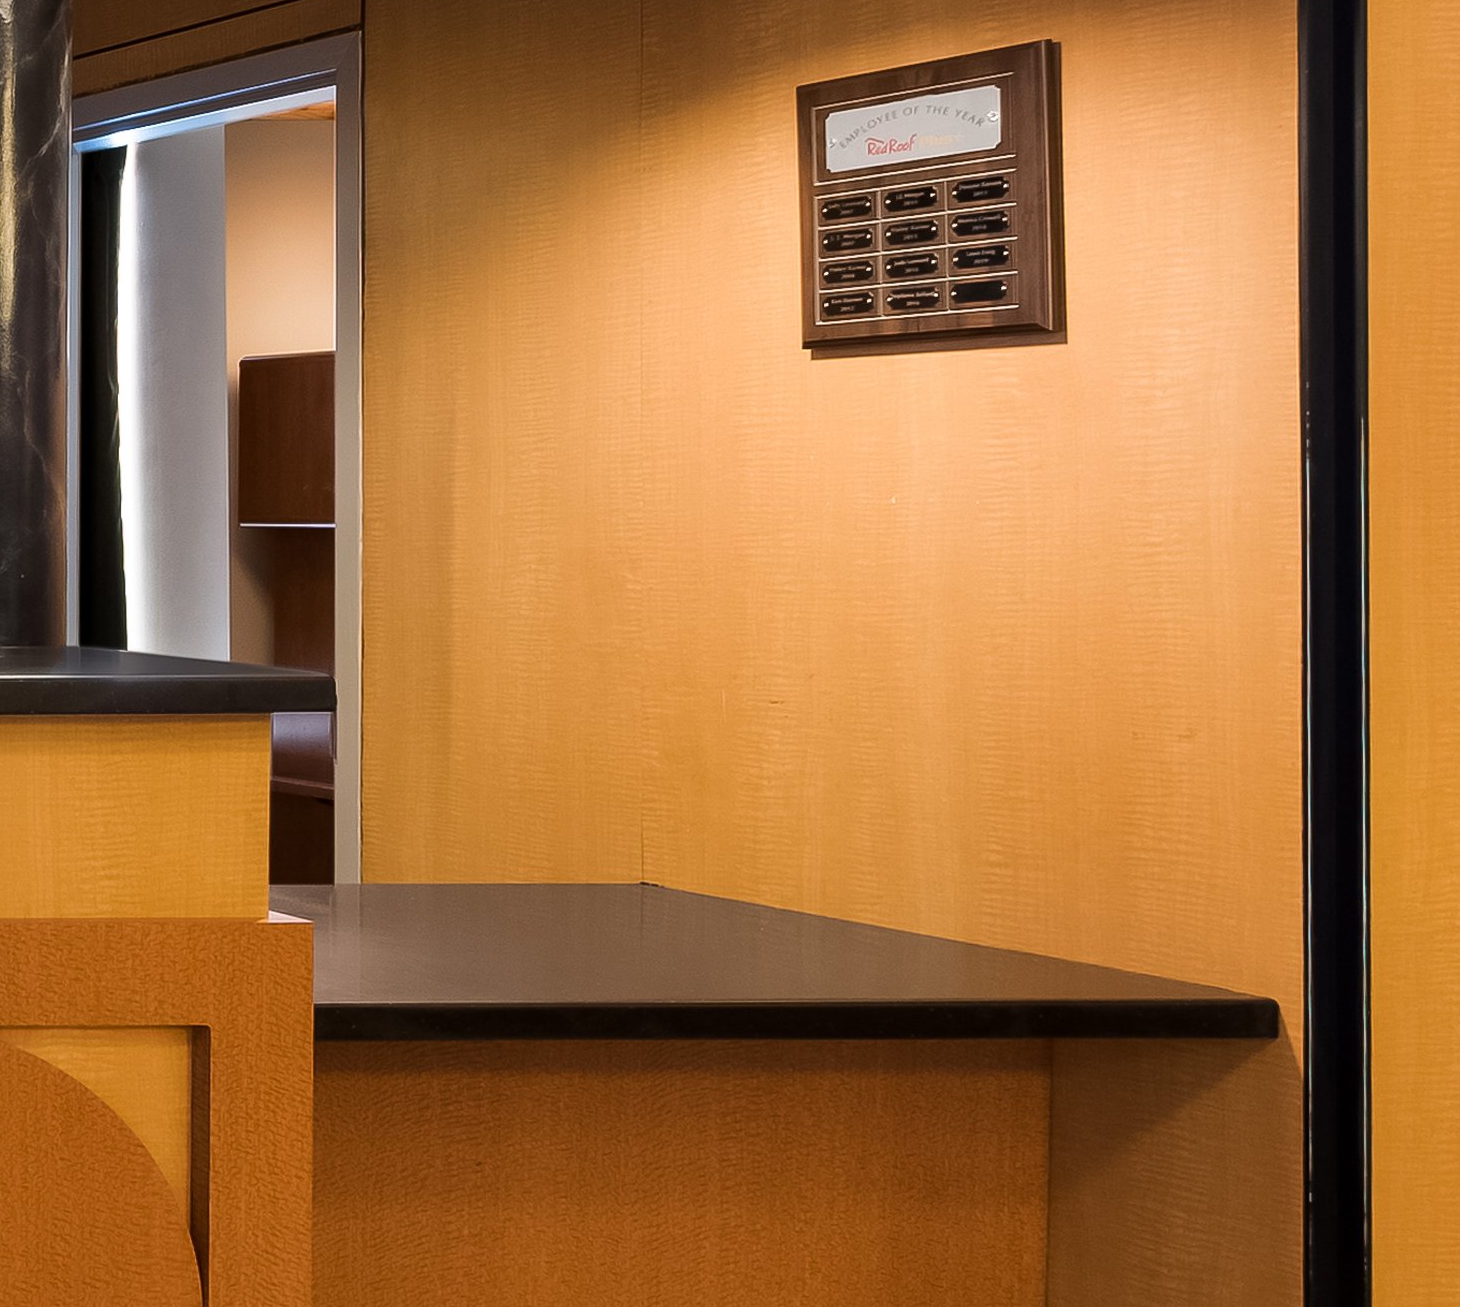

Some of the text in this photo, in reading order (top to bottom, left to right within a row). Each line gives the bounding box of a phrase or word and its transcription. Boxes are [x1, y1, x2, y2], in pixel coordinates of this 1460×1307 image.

[838, 105, 986, 149] EMPLOYEE OF THE YEAR
